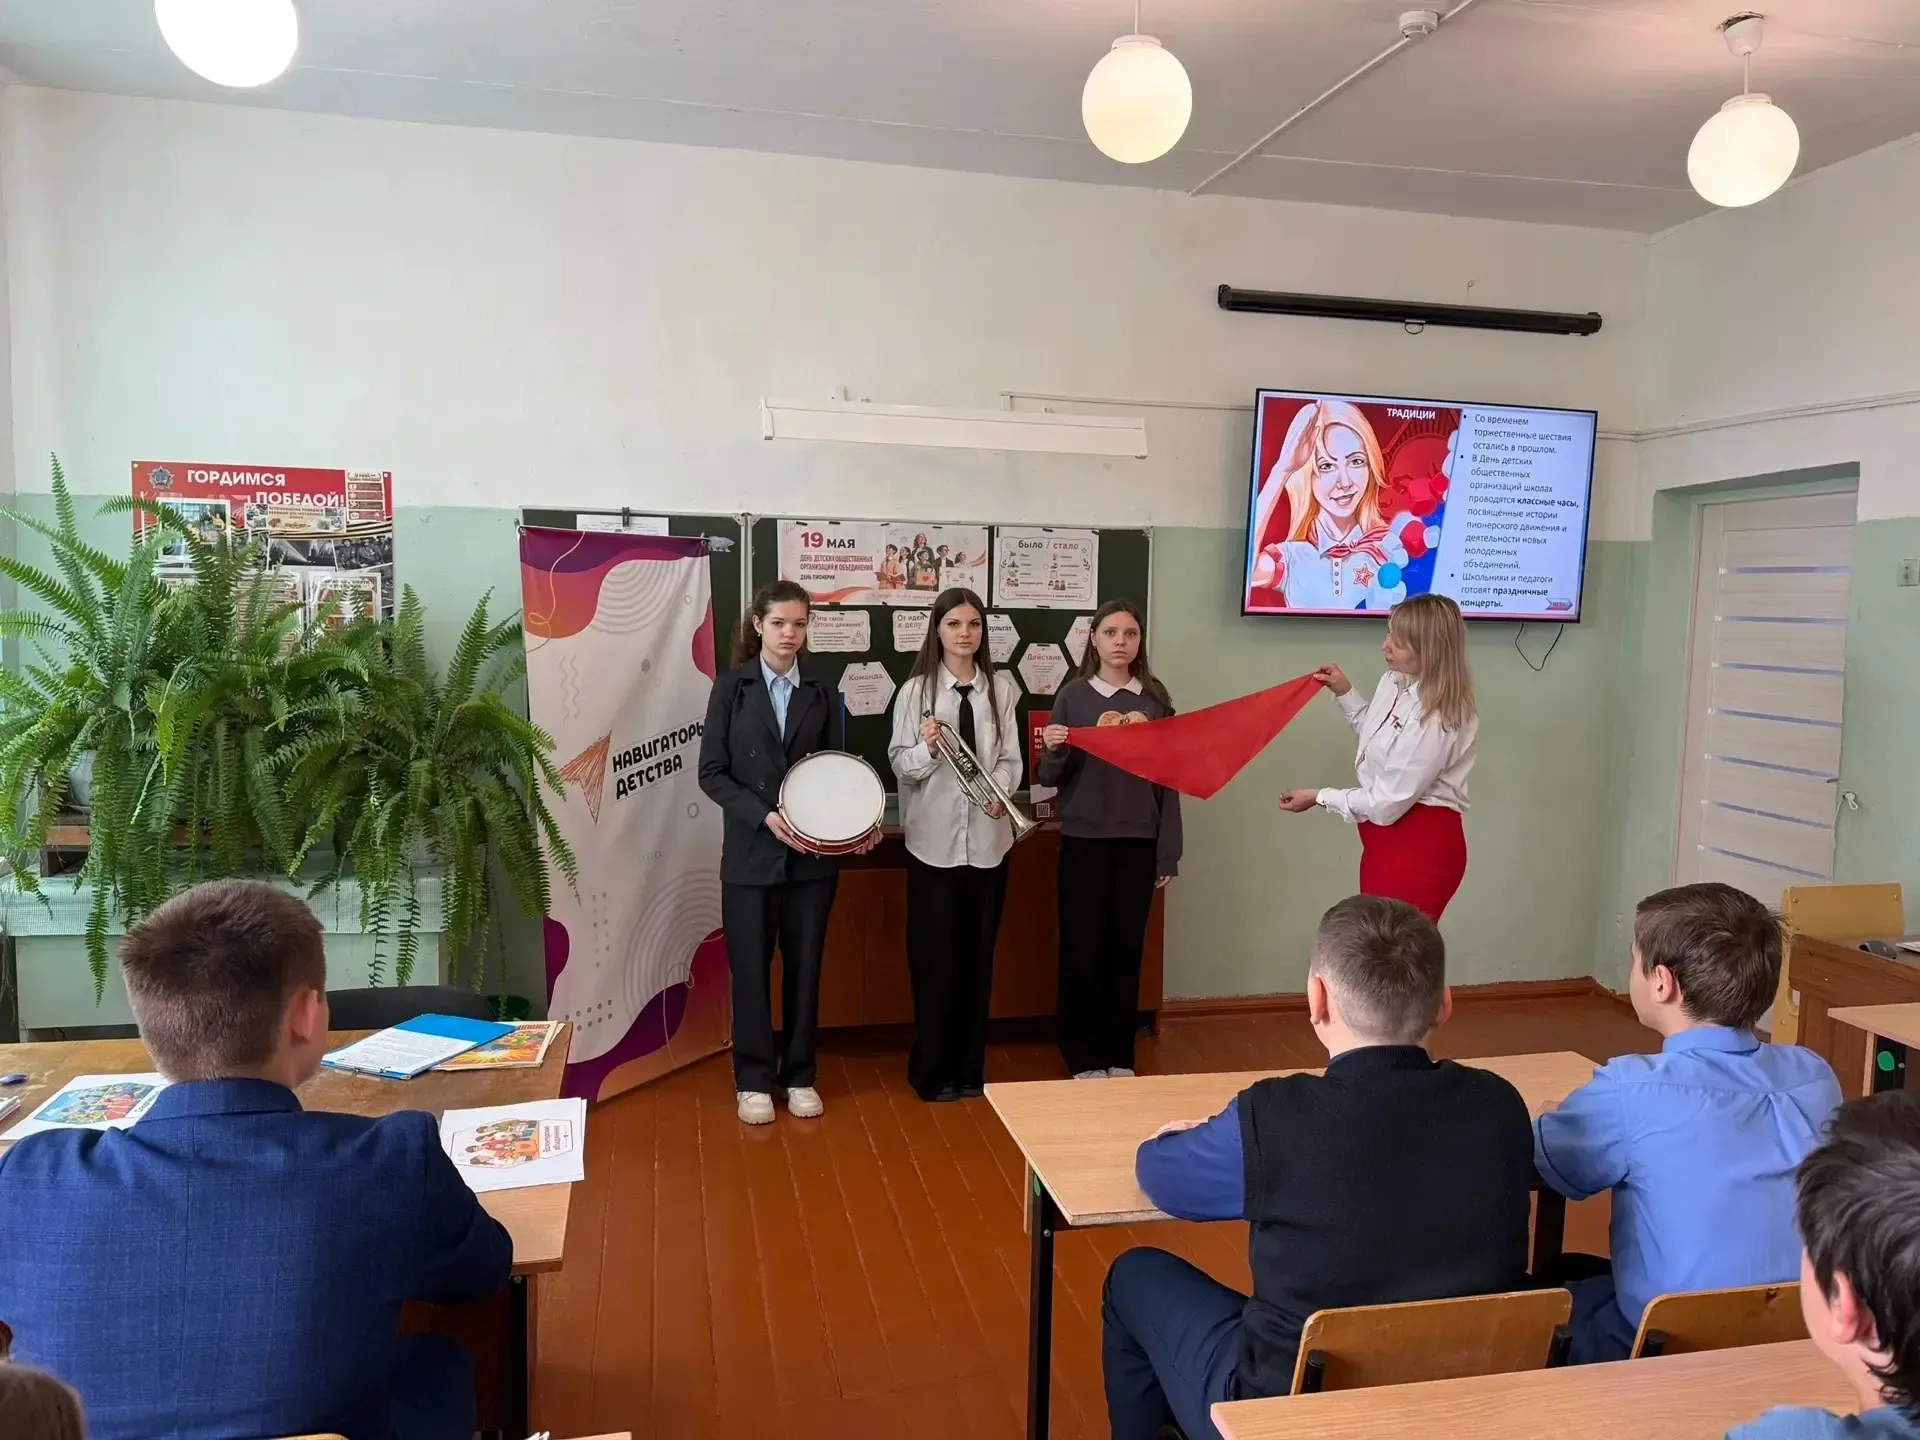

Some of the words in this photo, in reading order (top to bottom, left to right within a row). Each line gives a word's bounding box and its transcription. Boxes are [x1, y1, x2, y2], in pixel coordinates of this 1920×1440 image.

[1387, 408, 1436, 420] ТРАДИЦИИ
[1474, 414, 1486, 423] Со
[1487, 416, 1529, 426] временем
[1474, 428, 1537, 440] торжественные
[1538, 434, 1572, 442] шествия
[1472, 441, 1509, 451] остались
[1517, 445, 1558, 454] прошлом.
[1472, 454, 1478, 462] В
[1479, 455, 1500, 465] День
[1501, 458, 1533, 466] детских
[187, 469, 286, 486] ГОРДИМСЯ
[1470, 467, 1531, 479] общественных
[1469, 481, 1522, 493] организаций
[1523, 485, 1553, 493] школах
[256, 490, 345, 507] ПОБЕДОЙ!
[1468, 495, 1516, 505] проводятся
[1516, 498, 1556, 506] классные
[1557, 500, 1579, 508] часы,
[1525, 512, 1558, 520] истории
[1466, 521, 1519, 531] пионерского
[1519, 524, 1560, 533] движения
[801, 532, 824, 548] 19
[826, 538, 856, 549] МАЯ
[1465, 534, 1521, 543] деятельности
[1018, 540, 1043, 549] было
[1053, 542, 1079, 550] стало
[1463, 559, 1521, 570] объединений.
[1462, 573, 1509, 582] Школьники
[1518, 576, 1553, 584] педагоги
[1461, 587, 1491, 595] готовят
[1492, 588, 1548, 597] праздничные
[1460, 600, 1503, 608] концерты.
[848, 673, 883, 681] Команда
[616, 754, 683, 800] ДЕТСТВА
